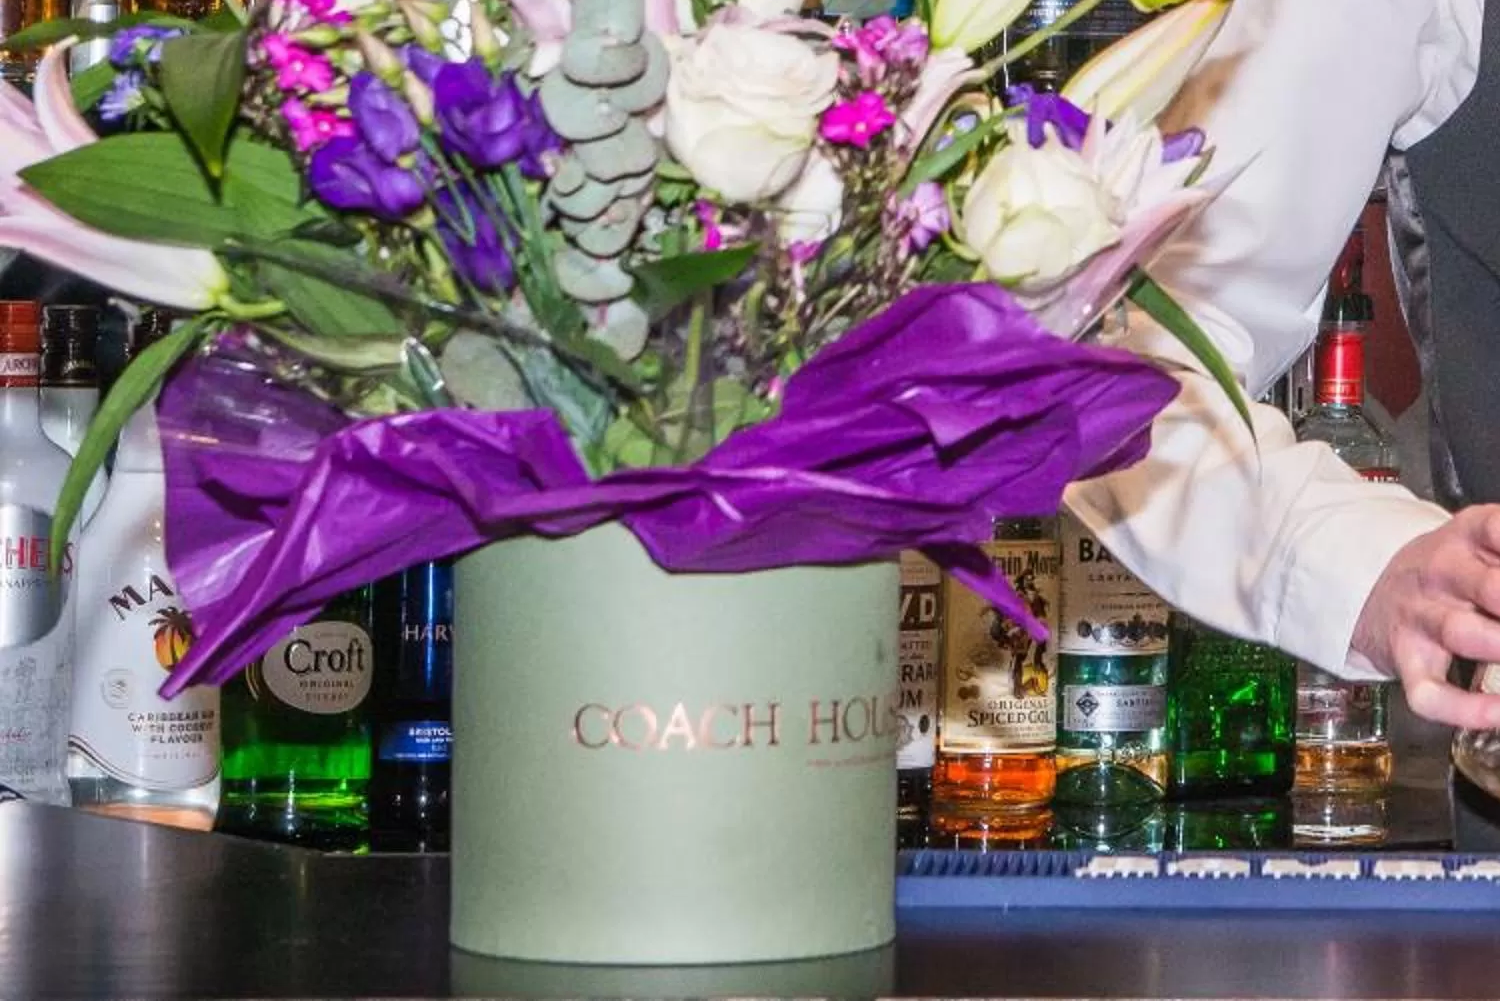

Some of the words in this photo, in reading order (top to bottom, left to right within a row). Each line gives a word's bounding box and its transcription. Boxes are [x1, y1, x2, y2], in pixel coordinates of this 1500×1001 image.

[283, 637, 365, 676] Croft
[571, 701, 780, 750] COACH
[967, 710, 1028, 729] SPICED
[150, 734, 204, 744] FLAVOUR
